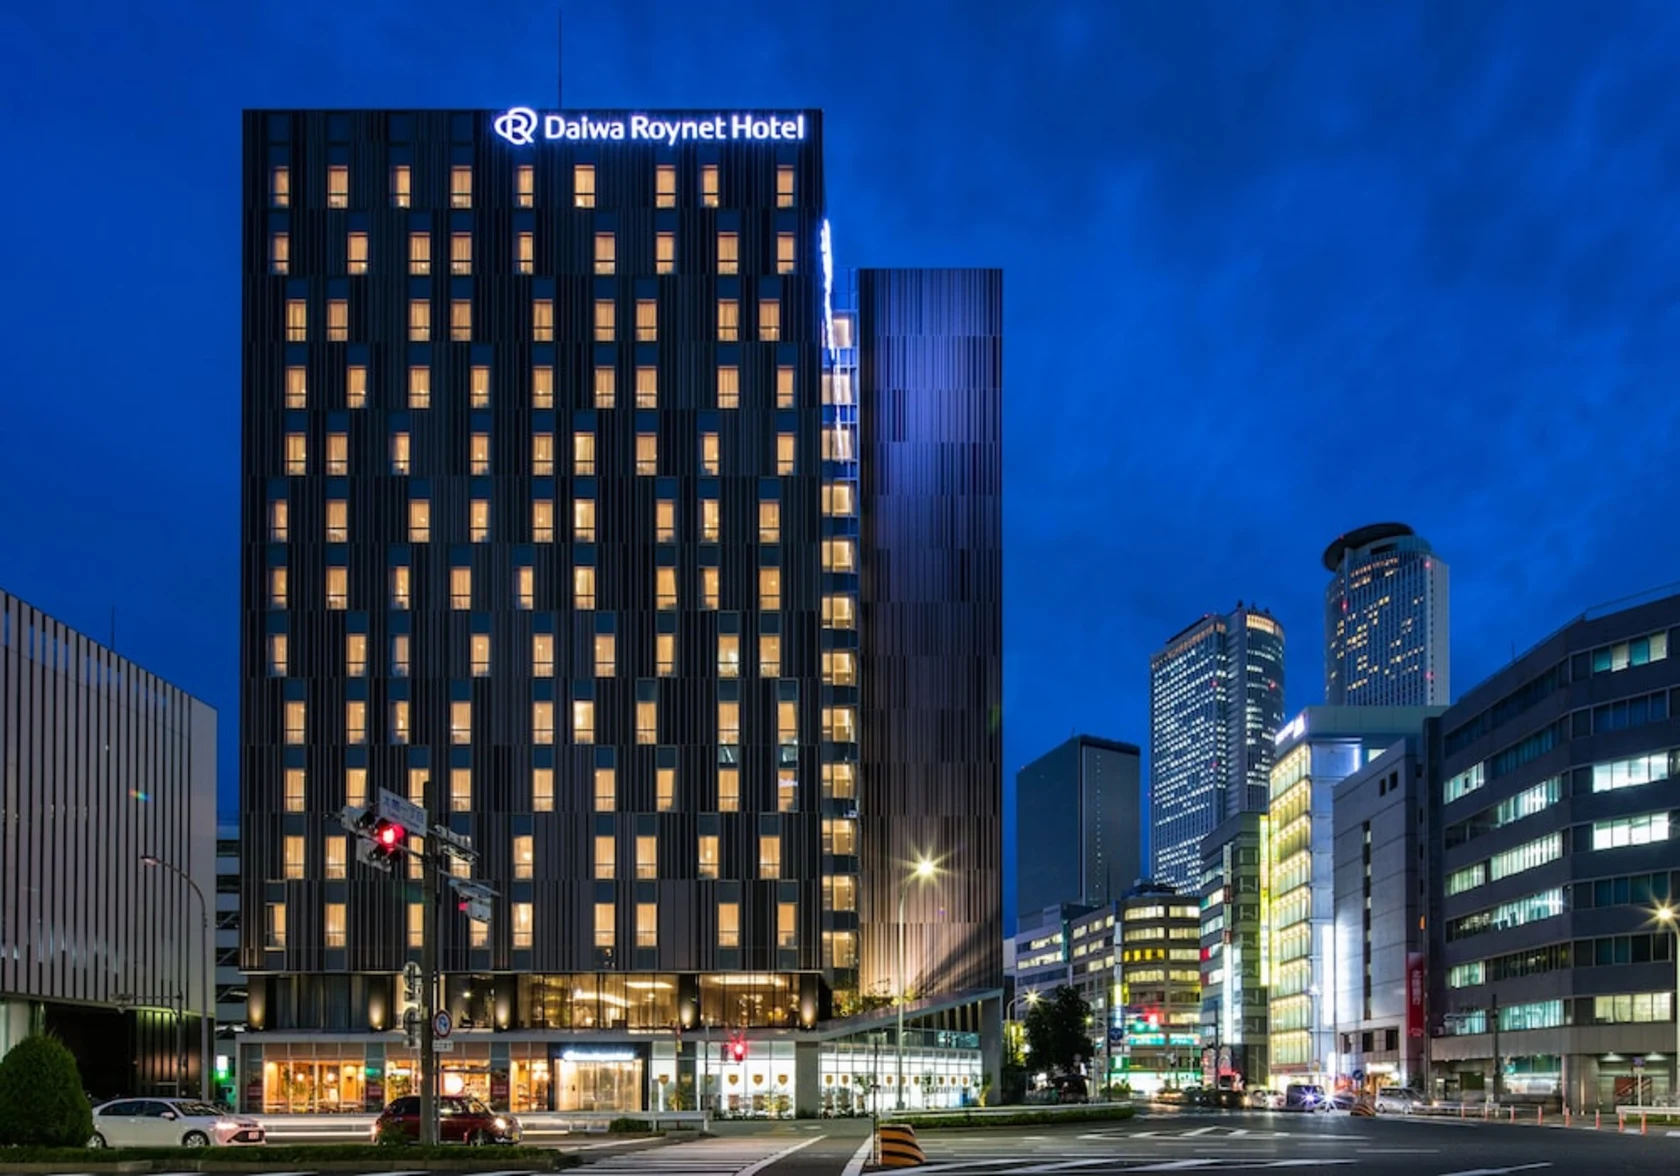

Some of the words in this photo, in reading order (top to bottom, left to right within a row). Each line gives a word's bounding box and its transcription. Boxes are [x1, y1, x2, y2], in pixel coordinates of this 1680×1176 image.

[545, 115, 625, 140] Daiwa
[631, 115, 726, 146] Roynet
[732, 114, 804, 140] Hotel
